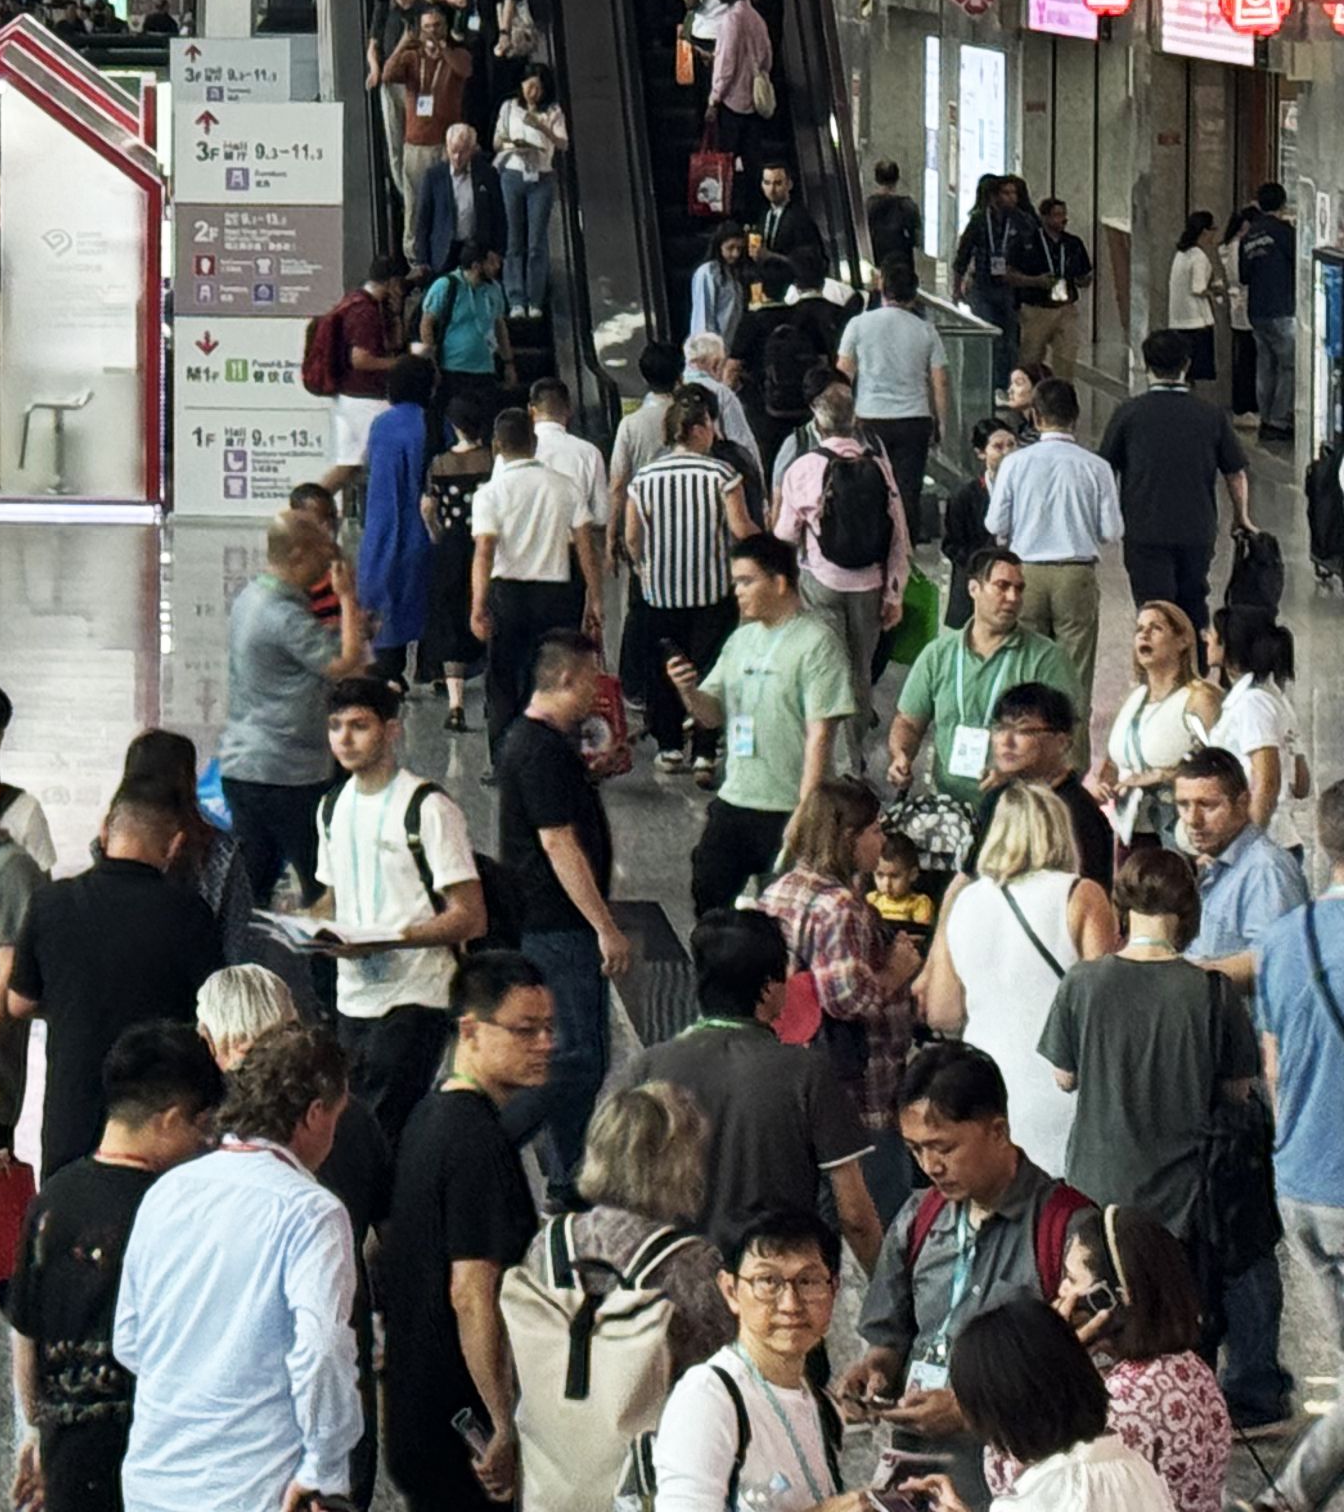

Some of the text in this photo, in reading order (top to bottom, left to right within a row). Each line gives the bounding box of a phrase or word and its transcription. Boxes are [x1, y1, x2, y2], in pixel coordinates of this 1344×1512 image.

[195, 140, 220, 163] 3F
[193, 219, 219, 243] 2F
[192, 425, 216, 448] 1F
